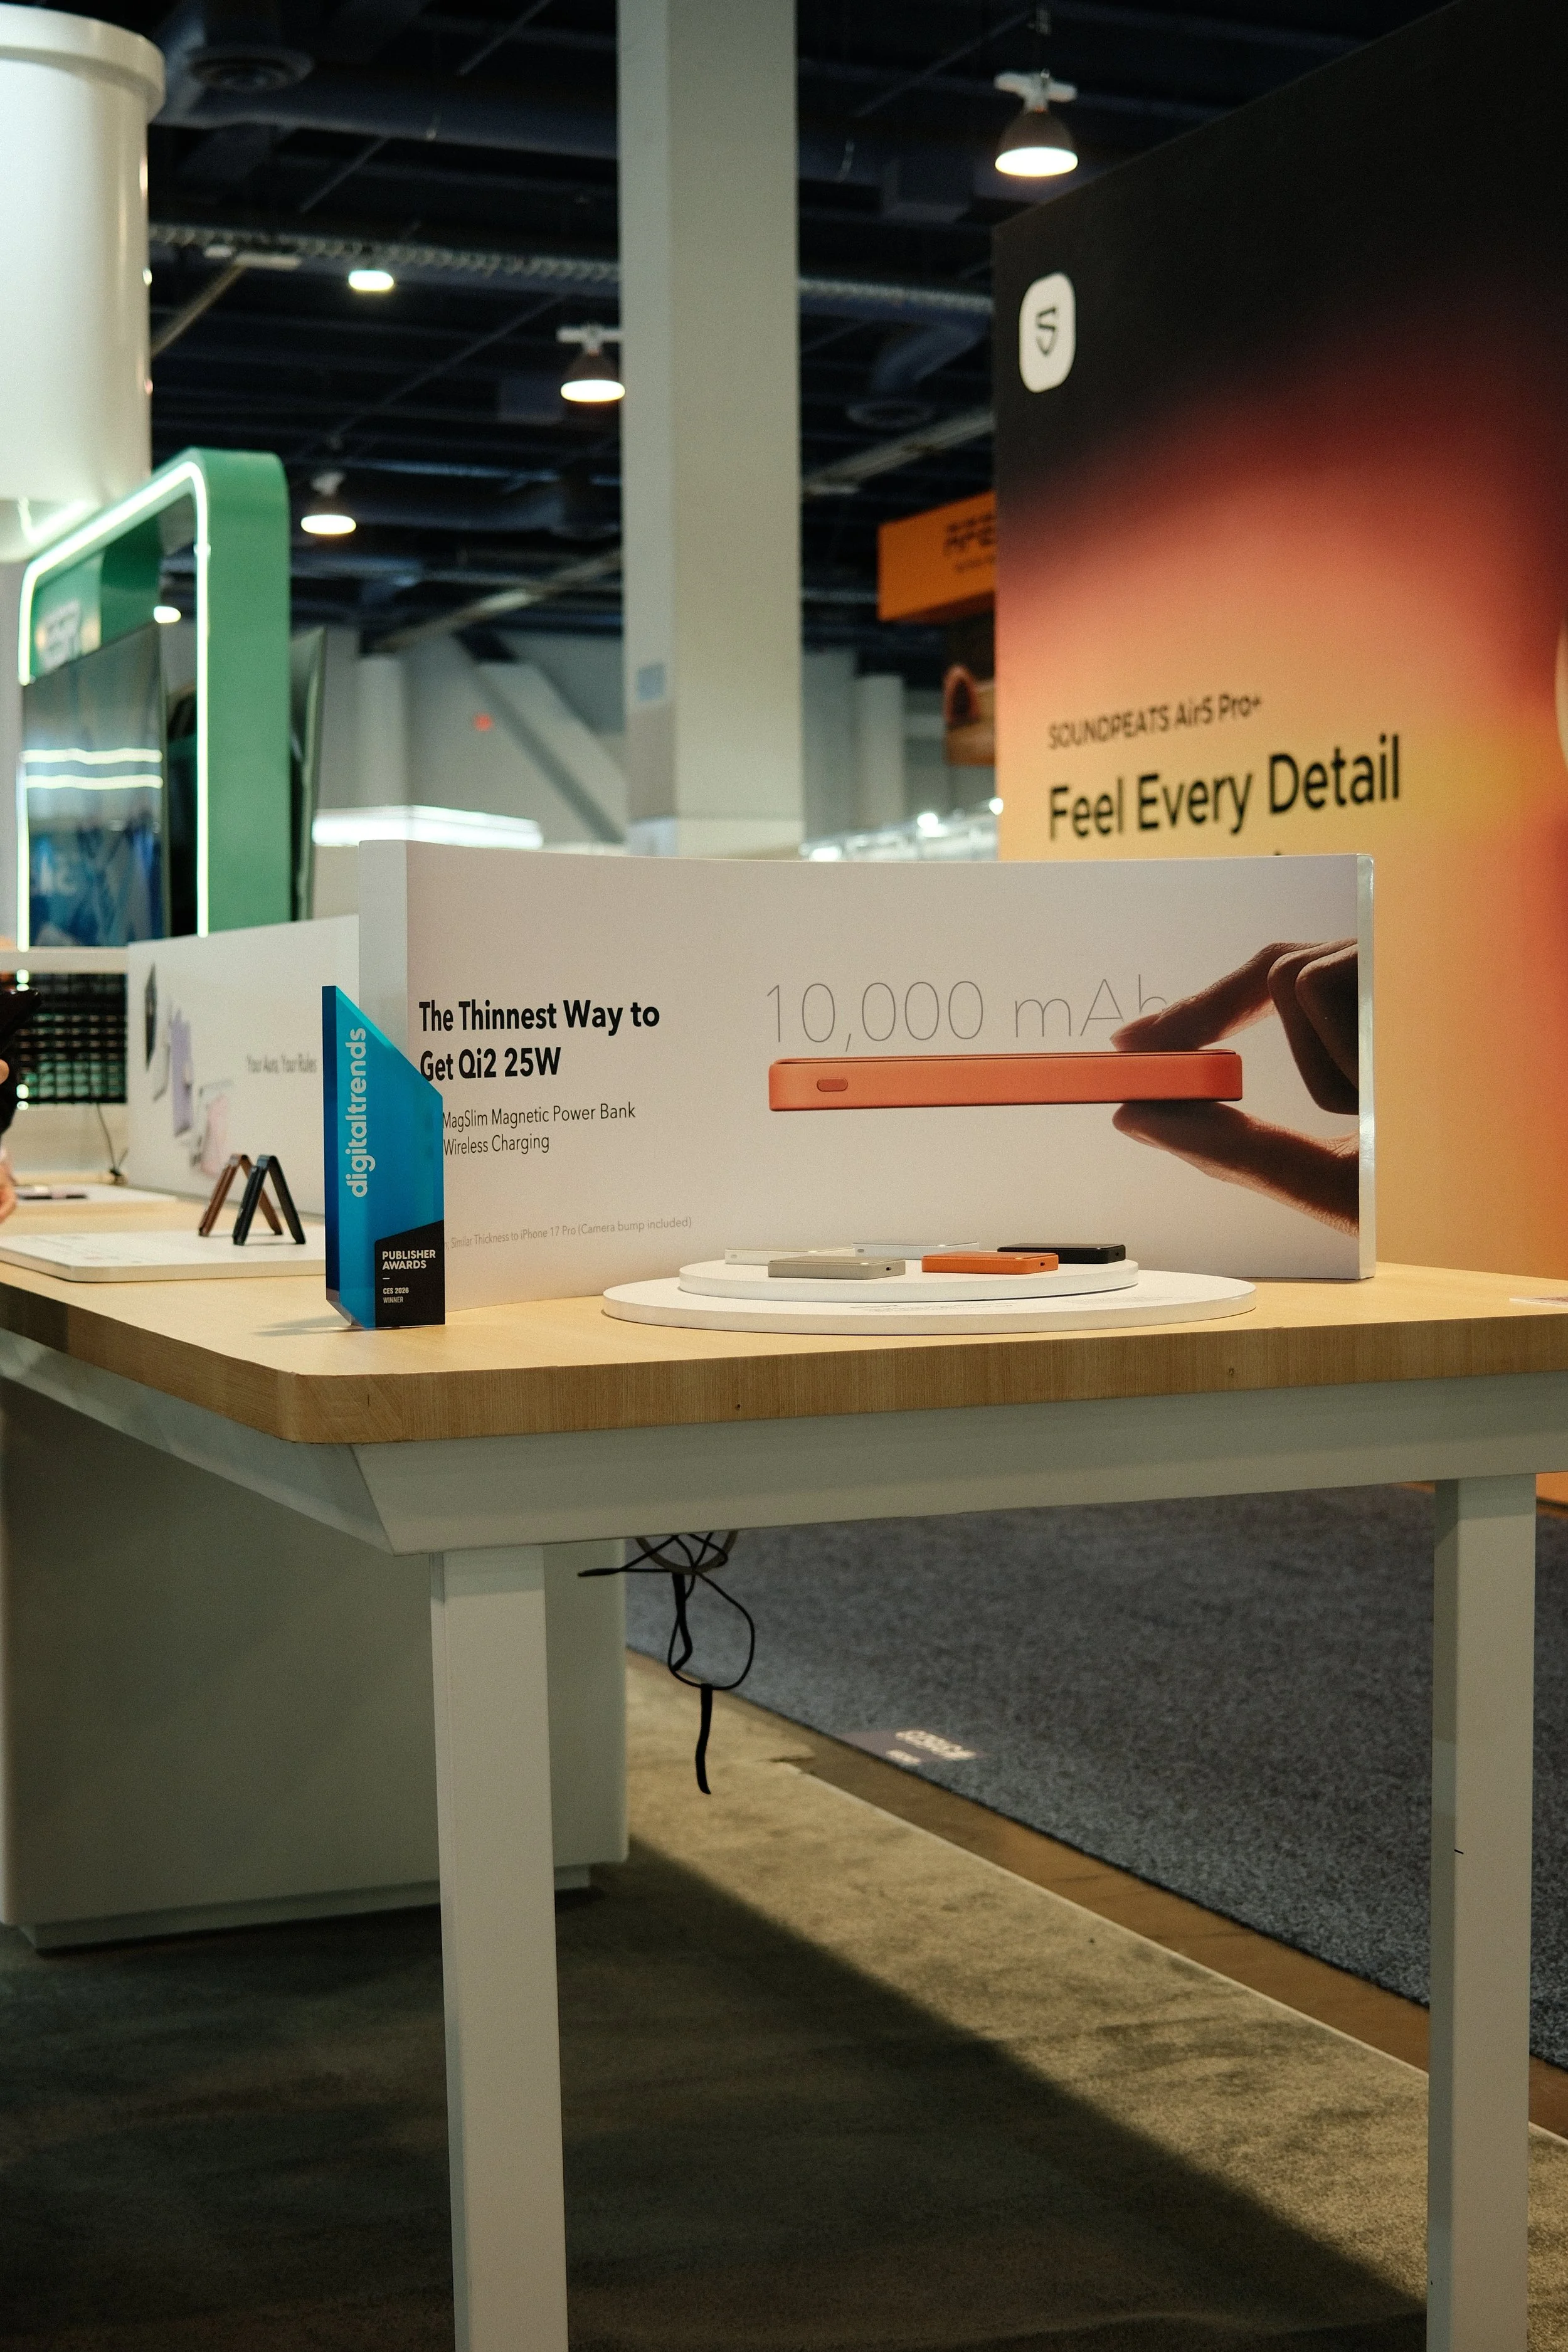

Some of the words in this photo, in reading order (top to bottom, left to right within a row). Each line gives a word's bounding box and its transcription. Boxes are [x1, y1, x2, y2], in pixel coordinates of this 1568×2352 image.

[1049, 776, 1125, 841] Feel
[1137, 771, 1253, 836] Every
[1269, 733, 1399, 815] Detail
[419, 999, 453, 1032] The
[458, 999, 557, 1030] Thinnest
[563, 999, 623, 1036] Way
[630, 1002, 660, 1027] to
[766, 980, 983, 1052] 10,000
[420, 1050, 453, 1081] Get
[458, 1047, 497, 1079] Qi2
[504, 1046, 561, 1078] 25W
[345, 1027, 376, 1198] digitaltrends
[443, 1109, 488, 1133] MagSlim
[492, 1106, 549, 1129] Magnetic
[553, 1105, 596, 1122] Power
[600, 1101, 636, 1120] Bank
[443, 1136, 489, 1156] Wireless
[492, 1133, 549, 1155] Charging
[451, 1236, 472, 1249] Similar
[474, 1232, 509, 1245] Thickness
[511, 1232, 519, 1241] to
[521, 1229, 548, 1240] iPhone
[550, 1226, 559, 1236] 17
[562, 1225, 576, 1235] Pro
[578, 1224, 615, 1236] (Camera
[618, 1221, 645, 1232] bump
[647, 1216, 692, 1230] included)
[382, 1249, 436, 1260] PUBLISHER
[382, 1259, 427, 1270] AWARDS
